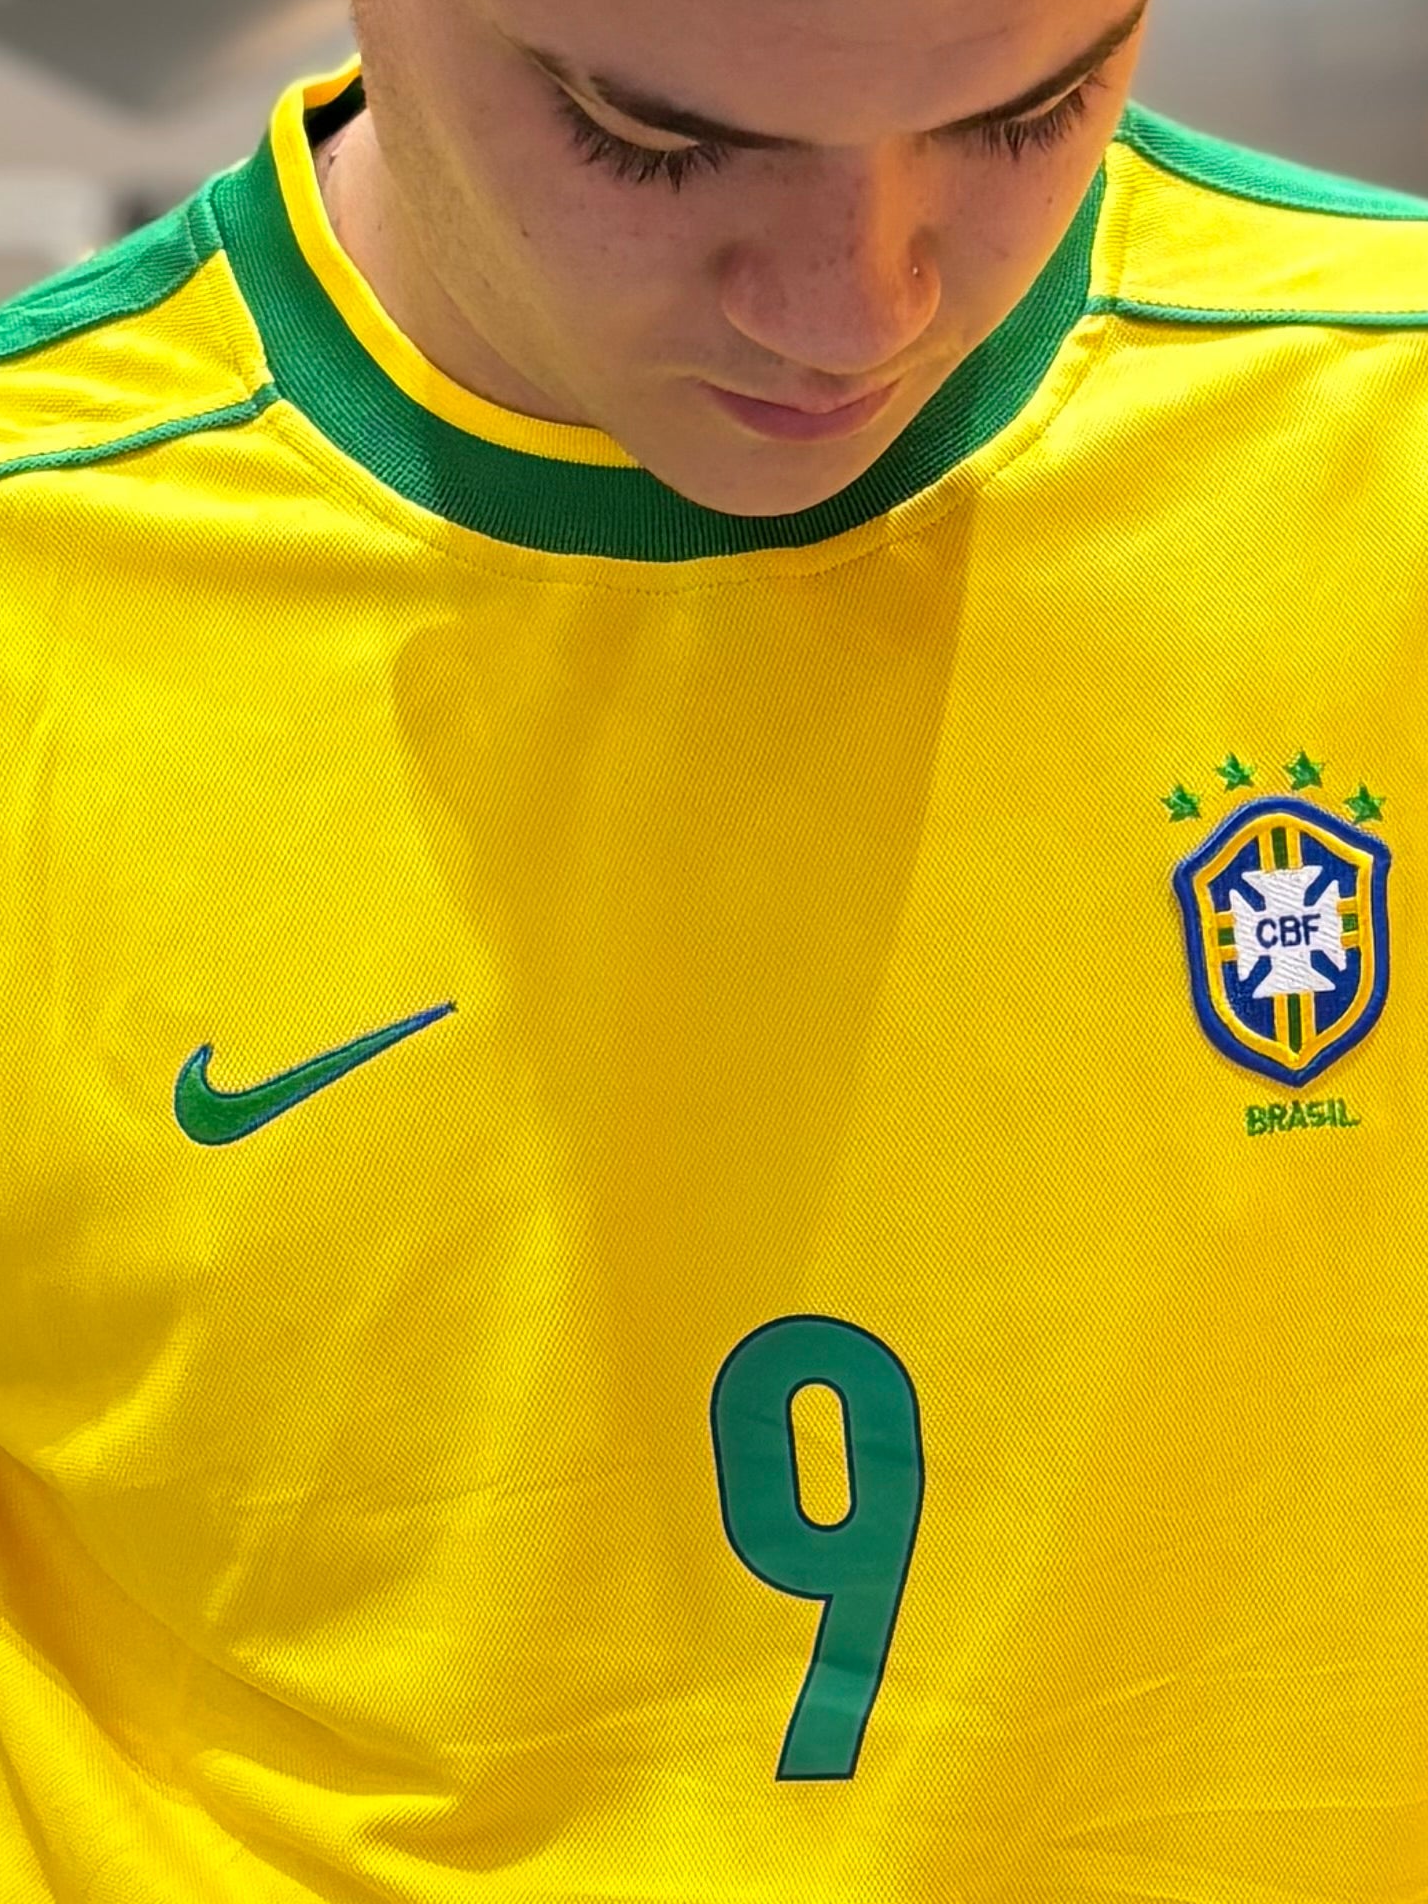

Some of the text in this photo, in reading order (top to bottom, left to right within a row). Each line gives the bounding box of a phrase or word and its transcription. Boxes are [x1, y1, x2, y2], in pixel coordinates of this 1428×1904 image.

[1255, 914, 1322, 948] CBF
[1245, 1099, 1361, 1137] BRASIL
[710, 1313, 925, 1781] 9
